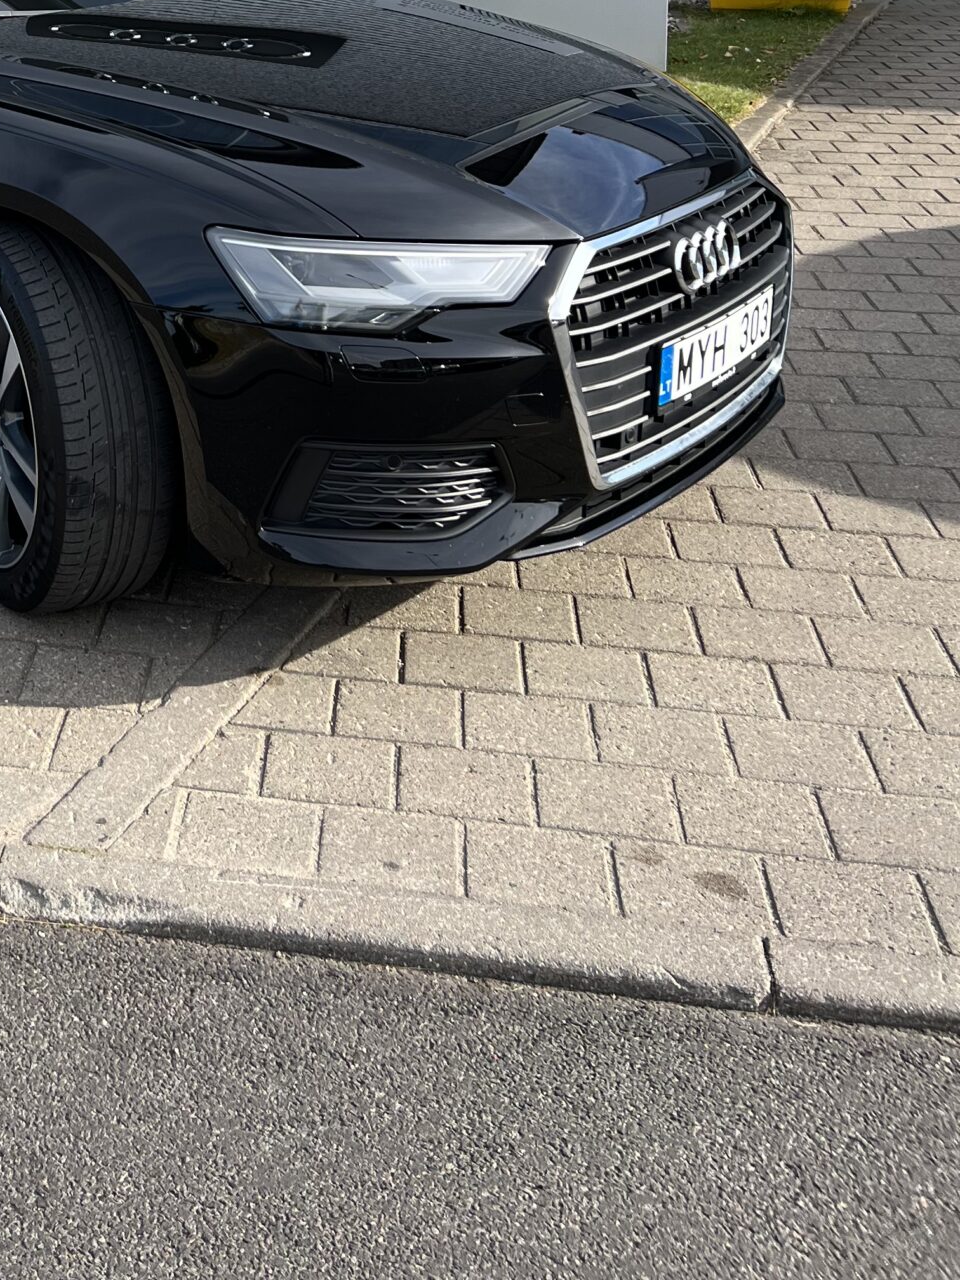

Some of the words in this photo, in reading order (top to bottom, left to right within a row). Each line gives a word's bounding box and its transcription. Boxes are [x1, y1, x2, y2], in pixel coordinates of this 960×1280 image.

[677, 325, 728, 391] MYH
[739, 298, 769, 353] 303
[659, 380, 672, 396] LT
